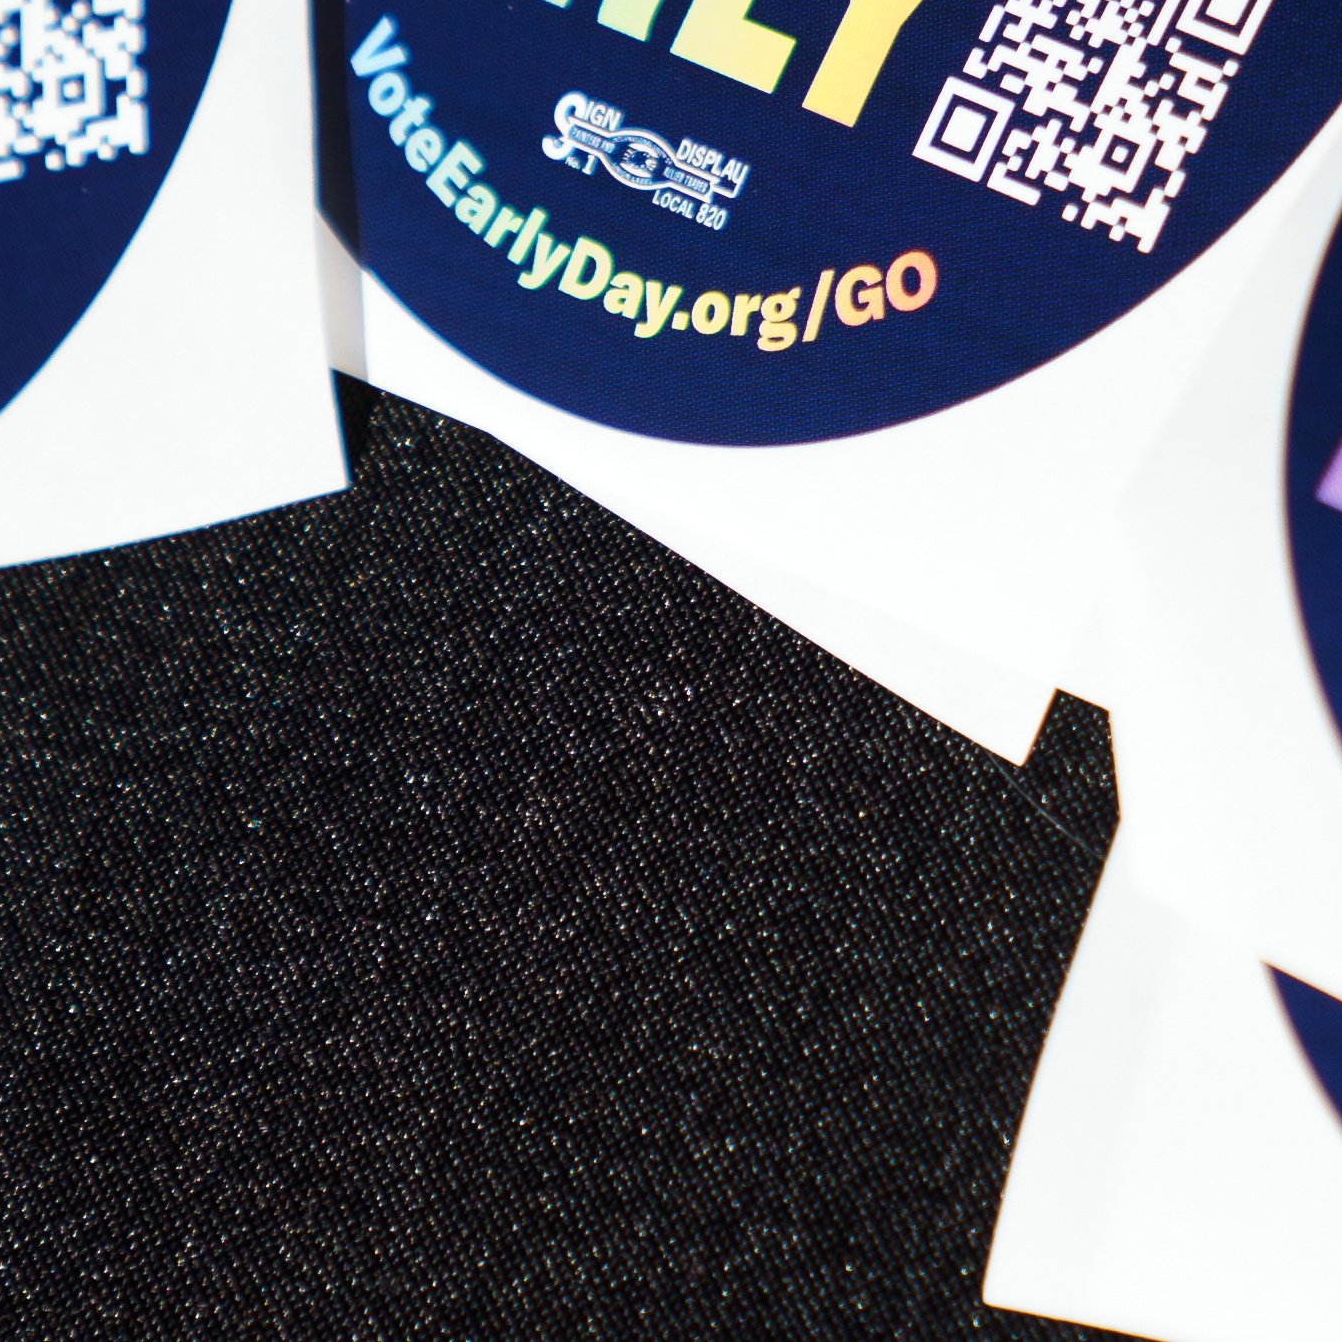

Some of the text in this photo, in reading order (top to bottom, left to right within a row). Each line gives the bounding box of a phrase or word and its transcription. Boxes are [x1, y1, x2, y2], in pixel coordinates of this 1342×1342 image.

[350, 15, 938, 352] VoteEarlyDay.org/GO
[676, 137, 750, 199] DISPLAY
[652, 190, 728, 231] LOCAL 820
